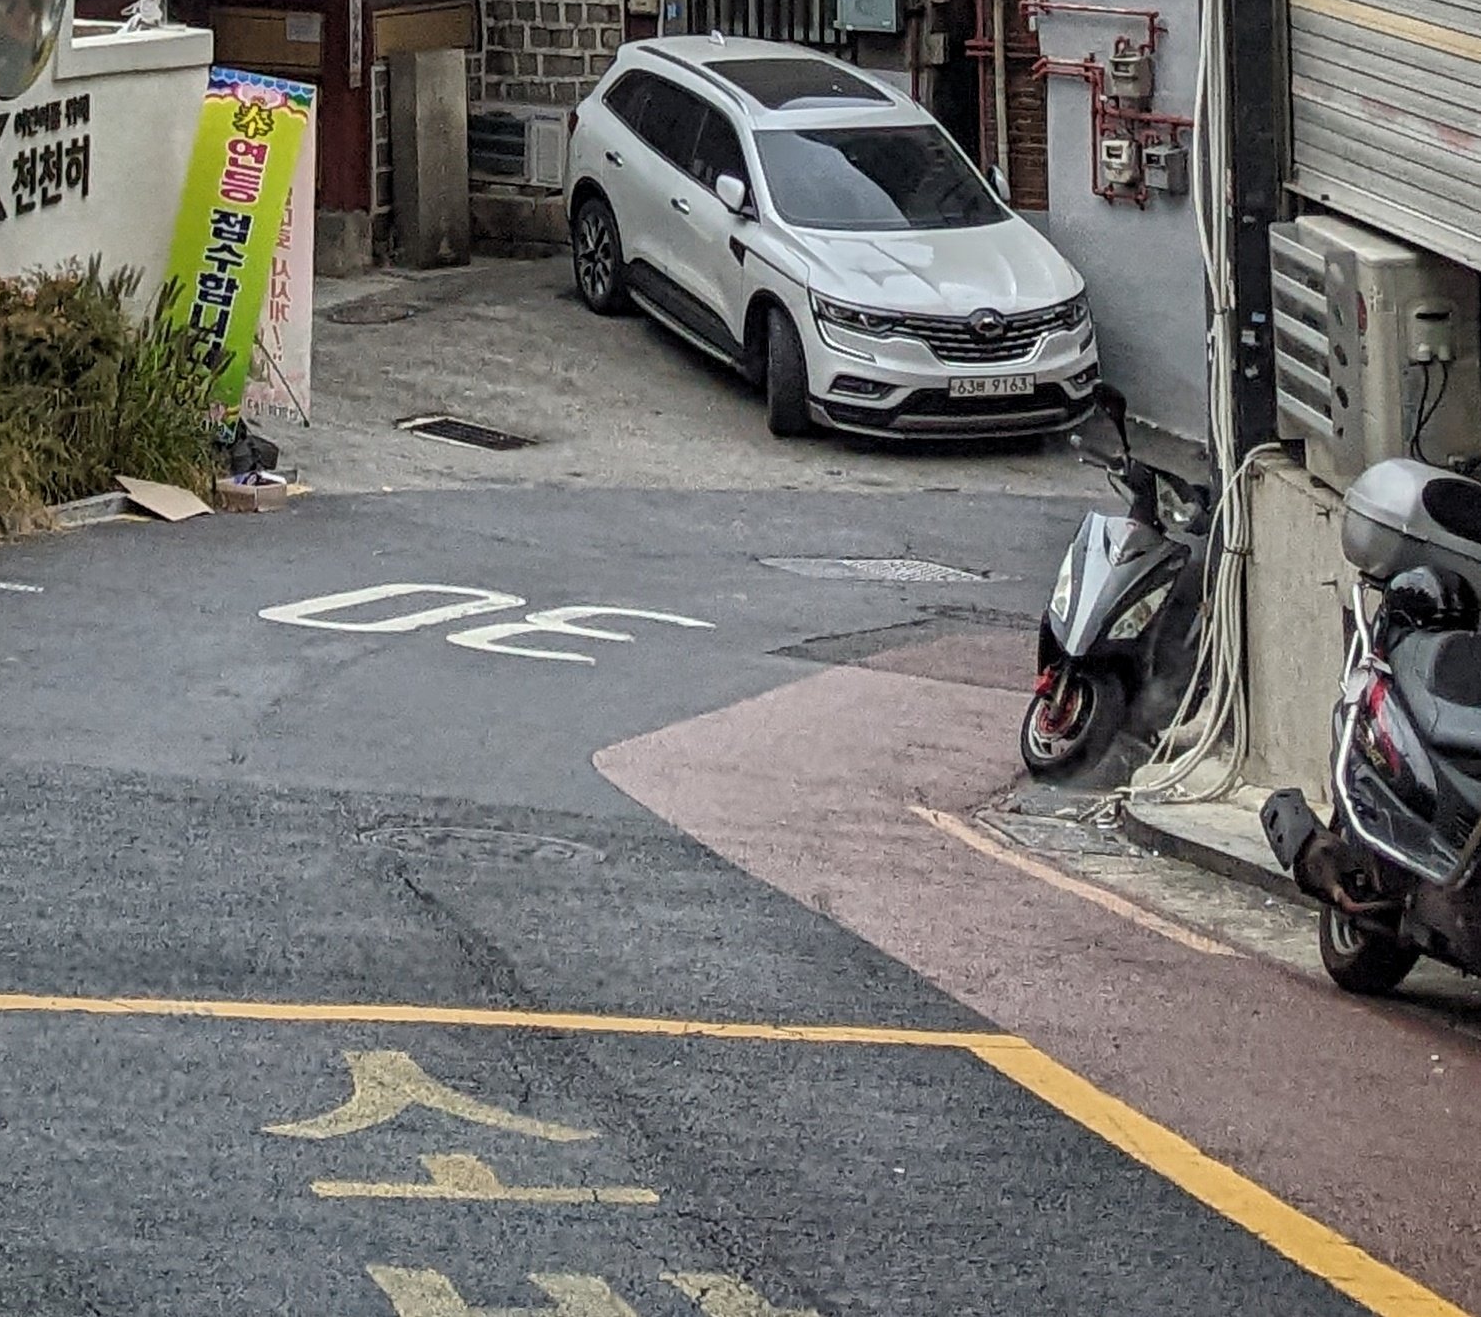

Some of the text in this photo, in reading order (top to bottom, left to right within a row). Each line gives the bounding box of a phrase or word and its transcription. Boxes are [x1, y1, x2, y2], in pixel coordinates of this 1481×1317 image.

[12, 134, 91, 217] 천천히
[220, 139, 269, 203] 연등
[992, 377, 1028, 393] 9163
